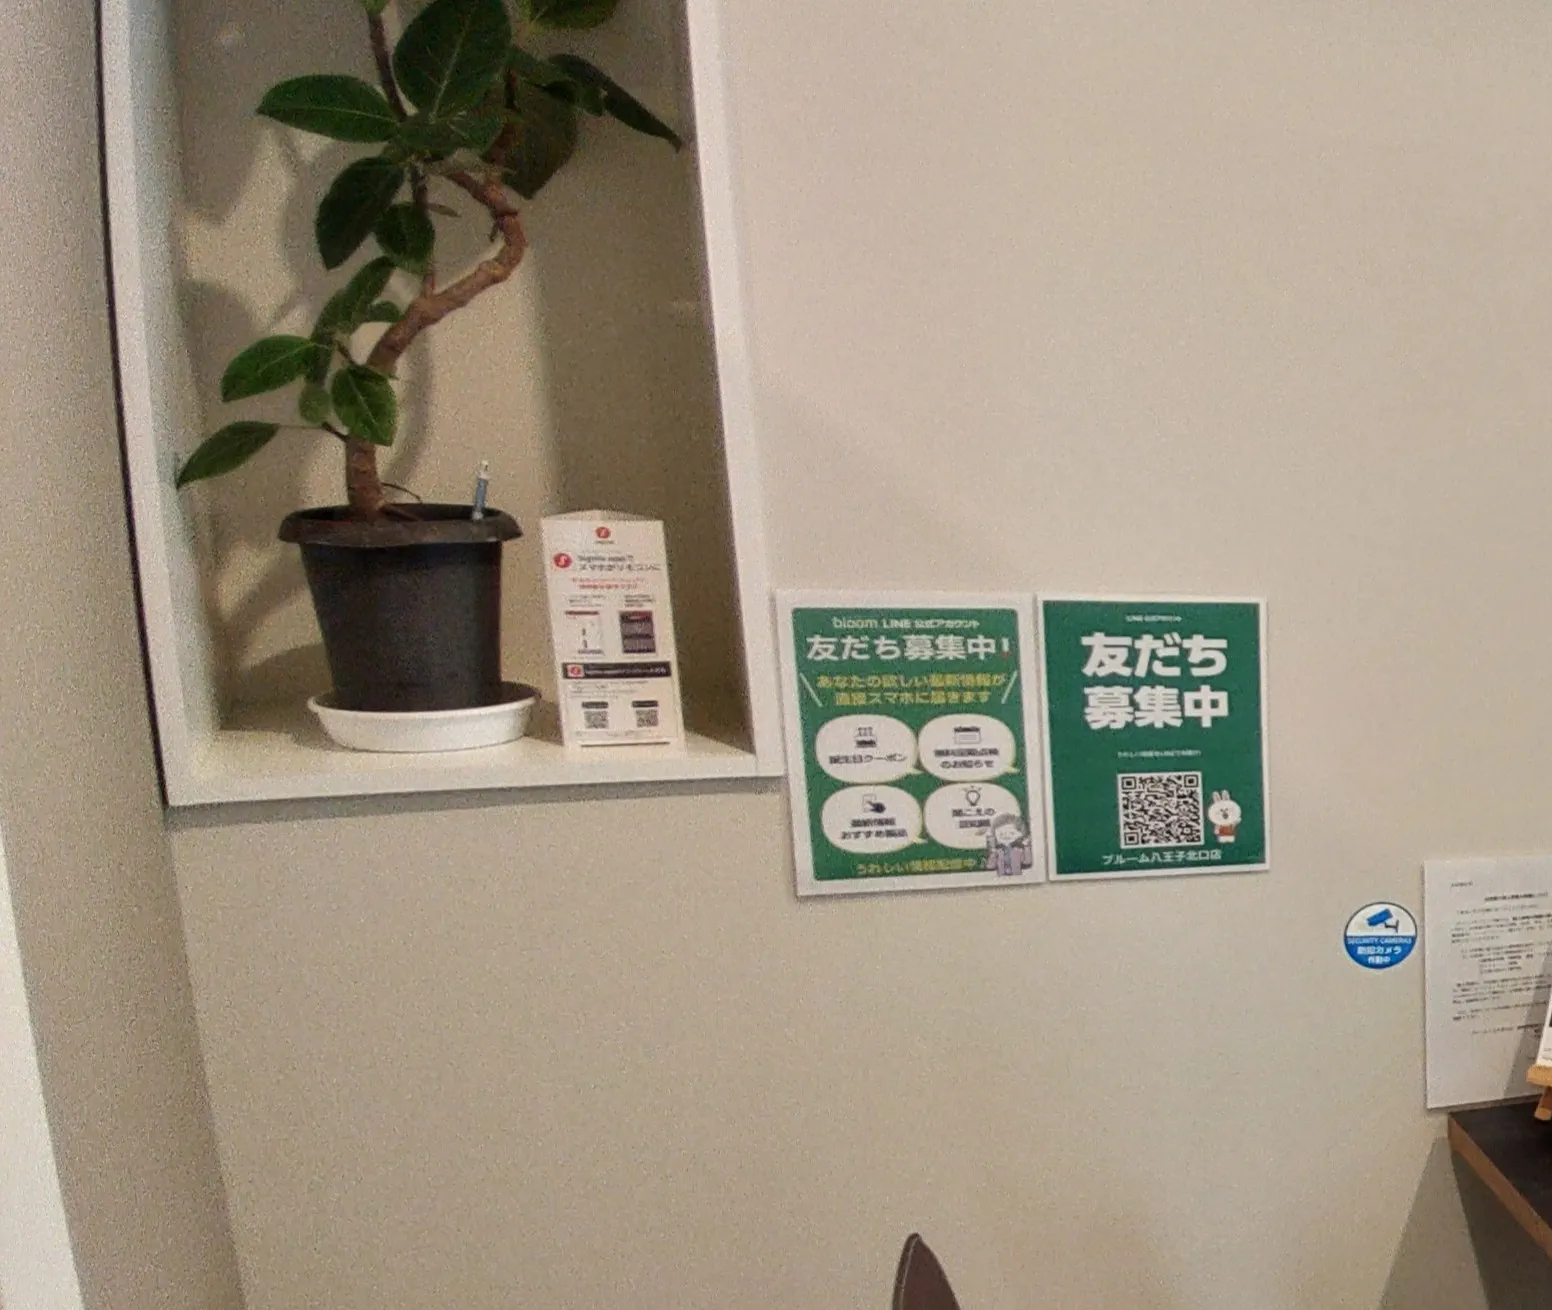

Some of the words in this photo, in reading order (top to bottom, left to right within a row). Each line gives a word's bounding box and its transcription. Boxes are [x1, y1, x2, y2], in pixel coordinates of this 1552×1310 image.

[832, 617, 878, 629] bloom
[882, 618, 911, 628] LINE
[914, 618, 980, 629] 公式アカウント
[1080, 632, 1228, 678] 友だち
[1083, 684, 1229, 730] 募集中
[1102, 850, 1222, 865] ブルーム八王子北口店
